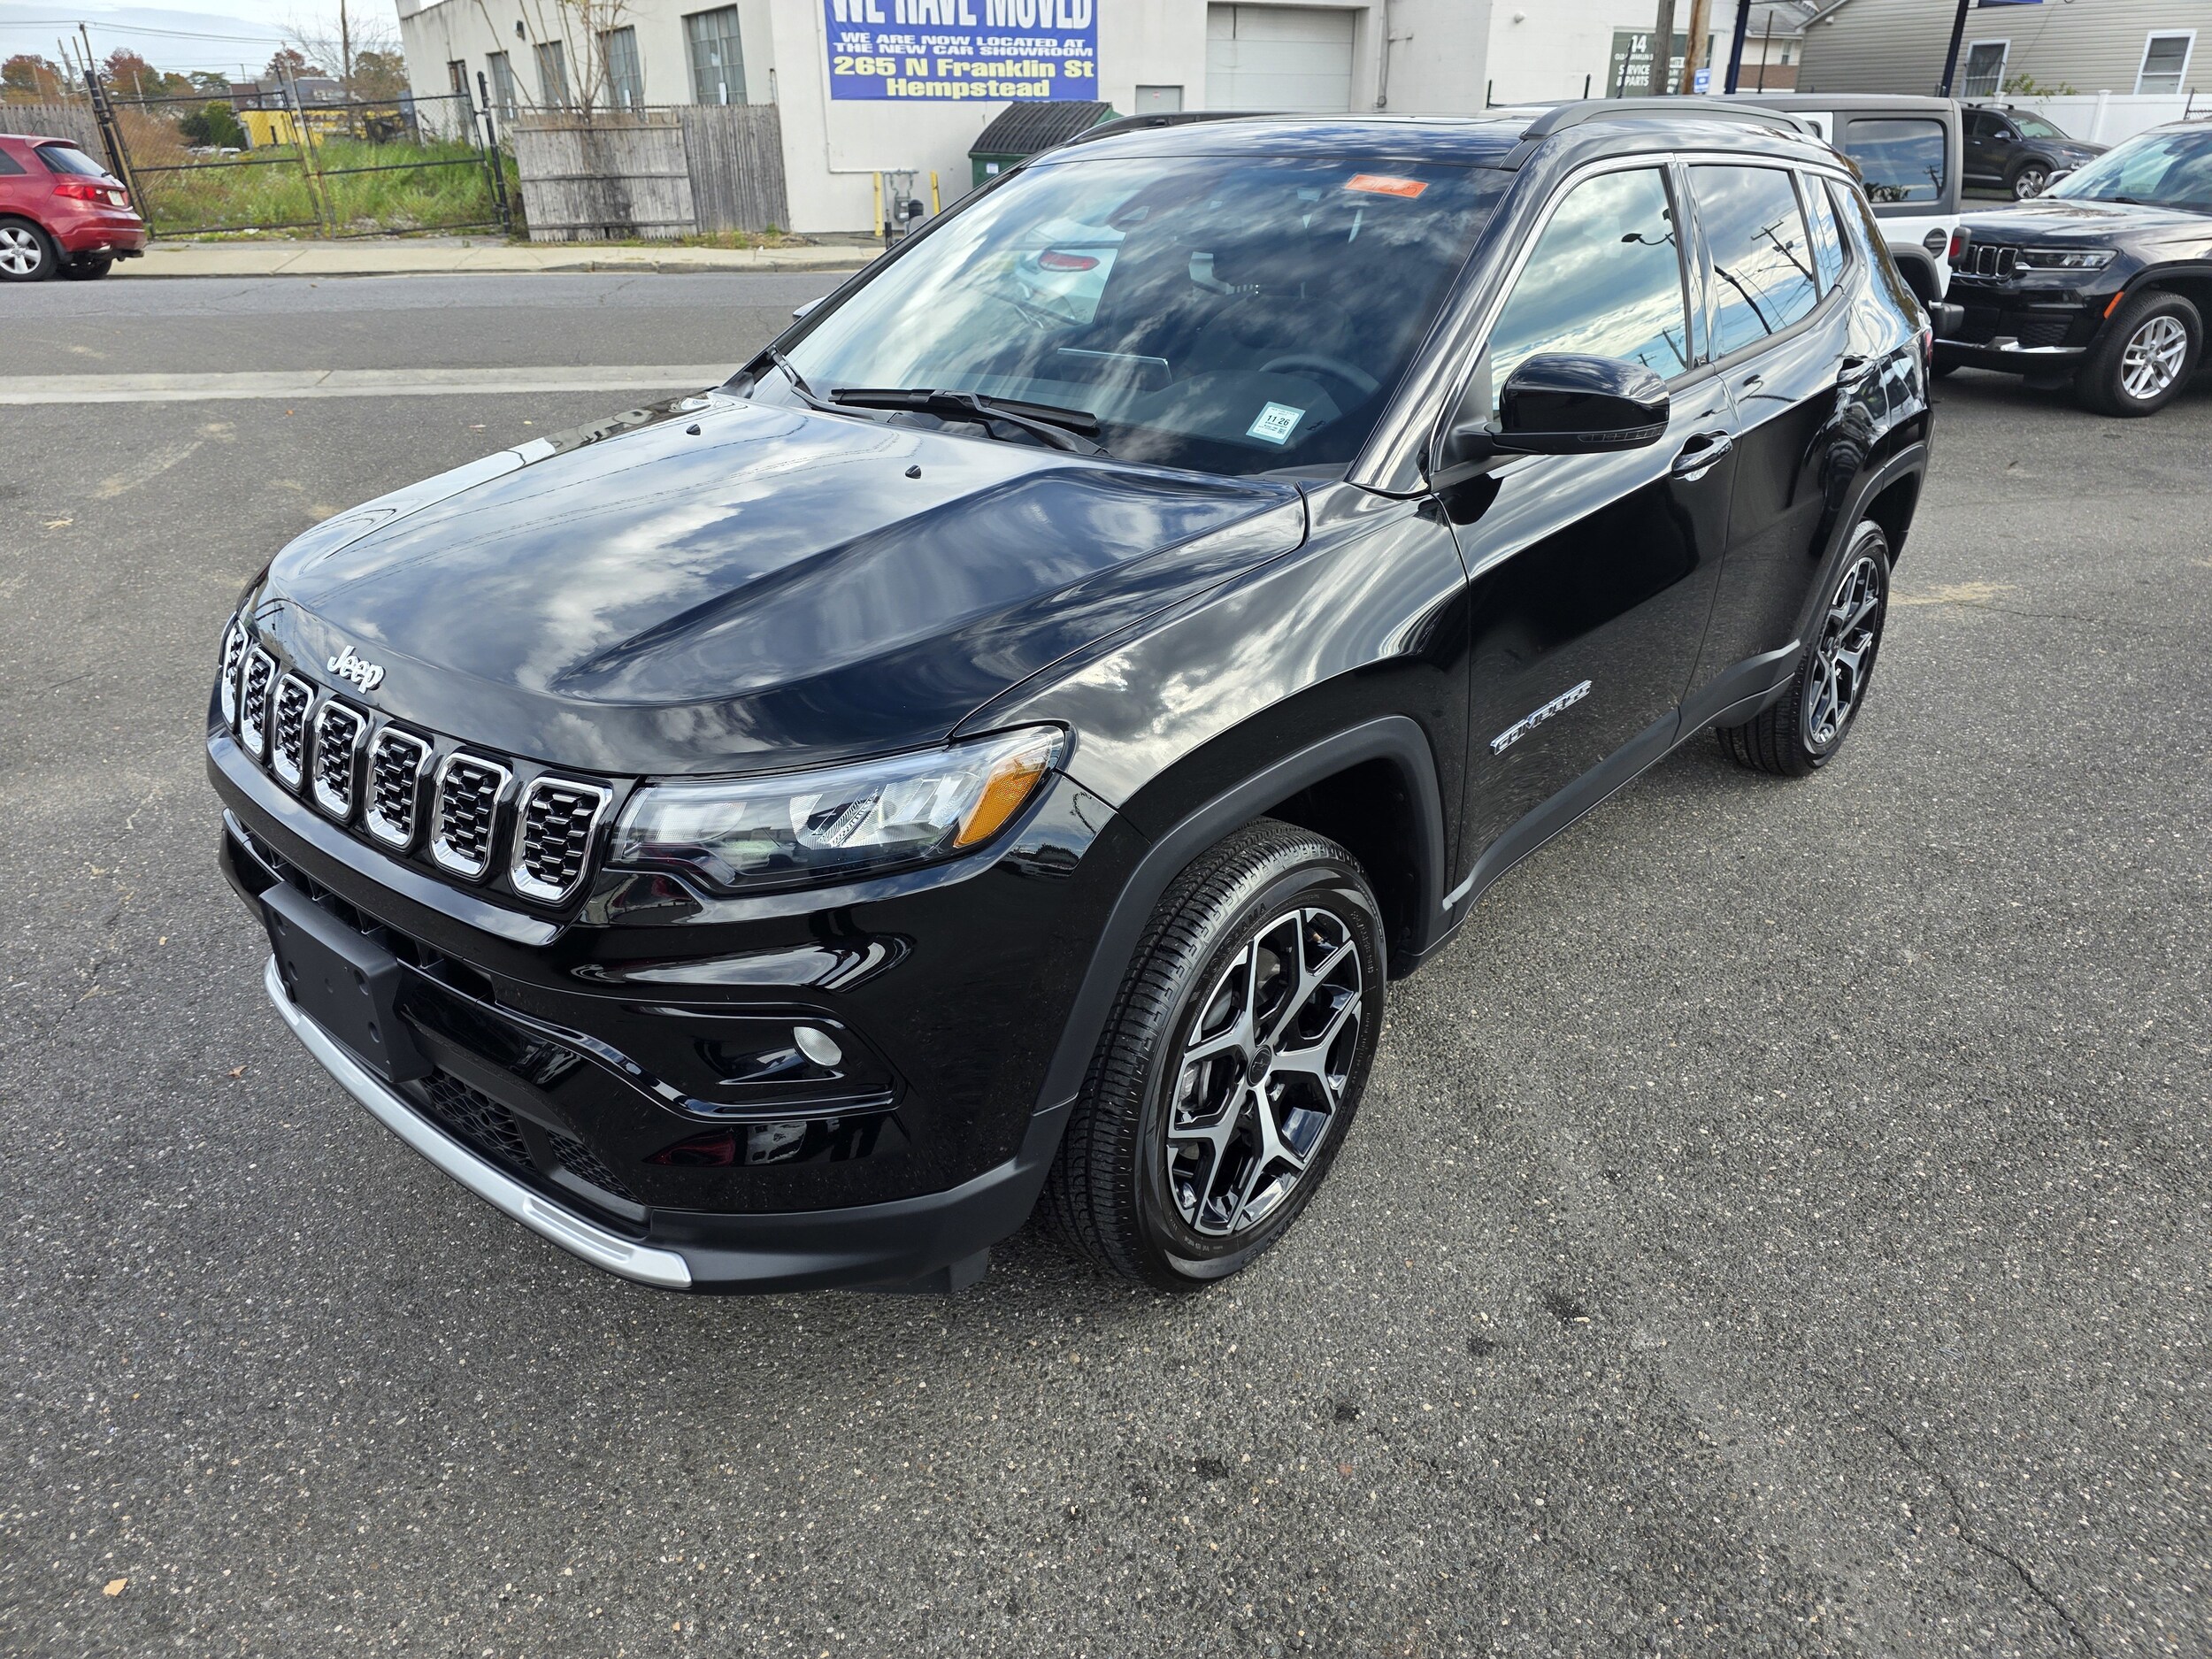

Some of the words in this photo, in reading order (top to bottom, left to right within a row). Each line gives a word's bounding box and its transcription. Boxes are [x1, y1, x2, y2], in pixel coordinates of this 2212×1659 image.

[841, 32, 871, 43] WE
[876, 35, 916, 44] ARE
[921, 35, 971, 45] NOW
[976, 36, 1058, 47] LOCATED
[1064, 39, 1086, 48] AT
[833, 42, 873, 53] THE
[879, 44, 926, 54] NEW
[933, 45, 973, 55] CAR
[979, 46, 1094, 57] SHOWROOM
[833, 56, 896, 75] 265
[905, 58, 928, 76] N
[937, 58, 1056, 78] Franklin
[1064, 59, 1094, 78] St
[1618, 65, 1651, 75] SRVICE
[887, 77, 1050, 99] Hempstead
[1624, 76, 1649, 87] PARTS
[326, 645, 385, 695] Jeep
